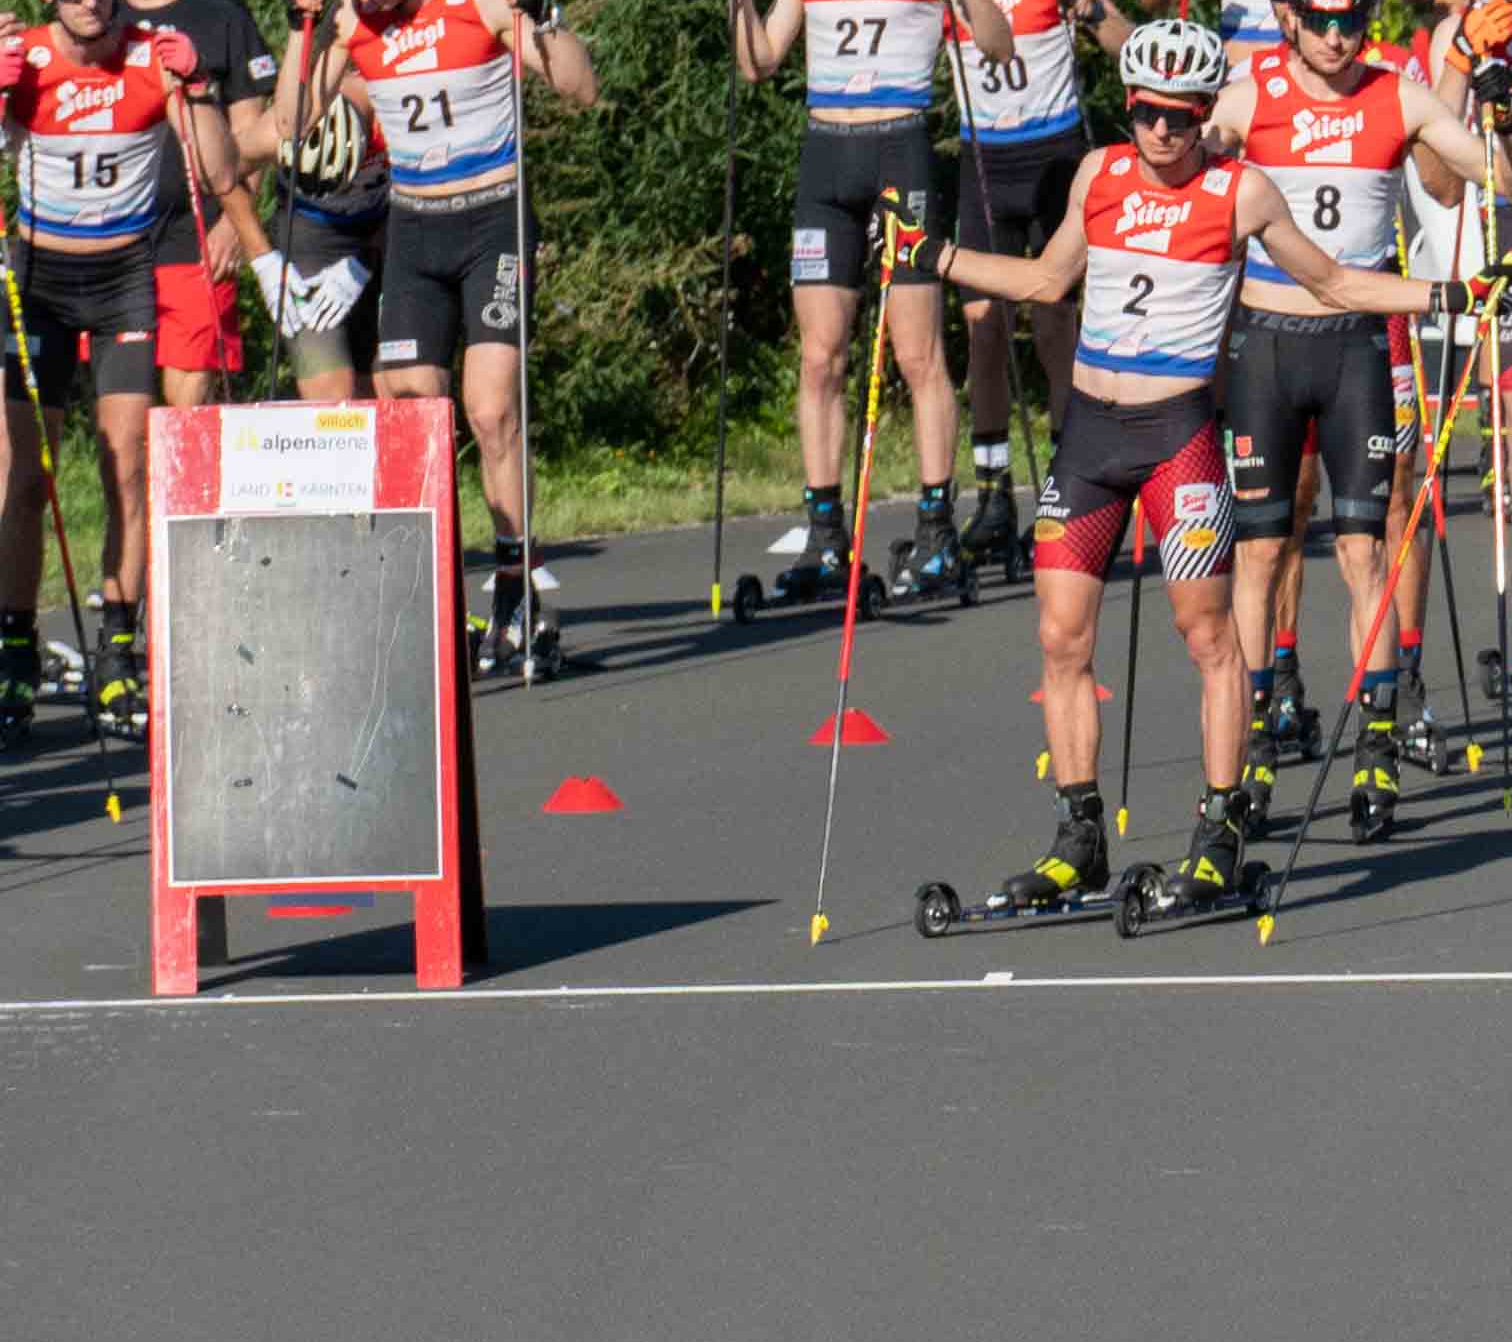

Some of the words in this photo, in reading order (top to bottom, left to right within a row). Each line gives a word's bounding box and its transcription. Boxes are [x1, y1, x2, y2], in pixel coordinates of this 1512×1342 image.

[836, 18, 887, 56] 27
[979, 56, 1028, 94] 30
[55, 79, 125, 123] Stiegl
[401, 89, 455, 133] 21
[1291, 108, 1364, 153] Stiegl
[67, 150, 118, 189] 15
[1115, 191, 1193, 236] Stiegl
[1314, 184, 1342, 231] 8
[1122, 274, 1155, 317] 2
[263, 433, 369, 453] alpenarena
